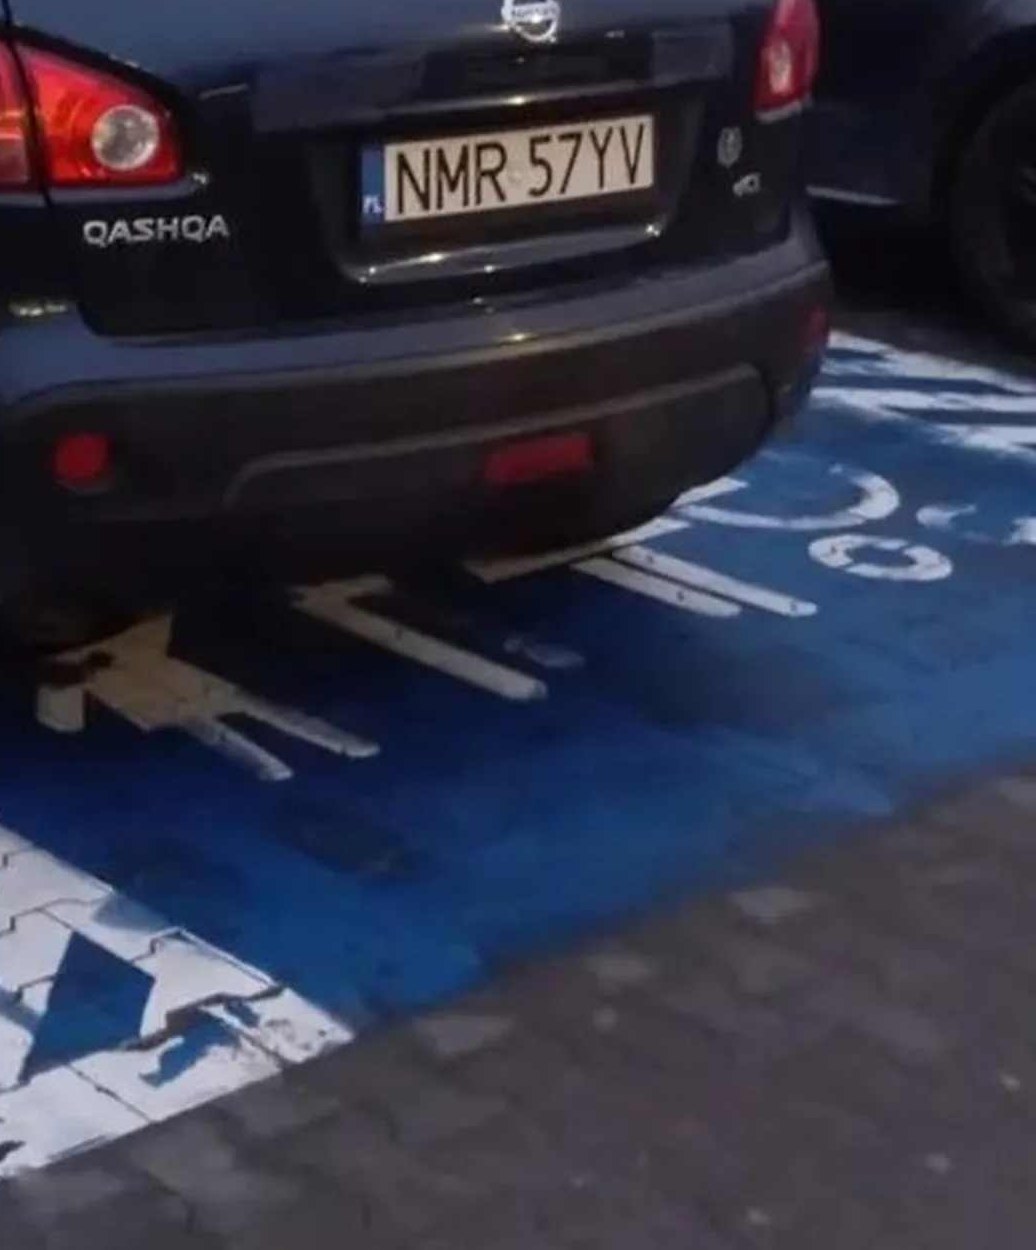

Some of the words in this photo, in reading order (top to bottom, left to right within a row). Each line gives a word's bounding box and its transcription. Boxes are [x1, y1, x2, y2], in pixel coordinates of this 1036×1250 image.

[396, 141, 507, 214] NMR
[528, 124, 645, 199] 57YV
[83, 214, 230, 248] QASHQA
